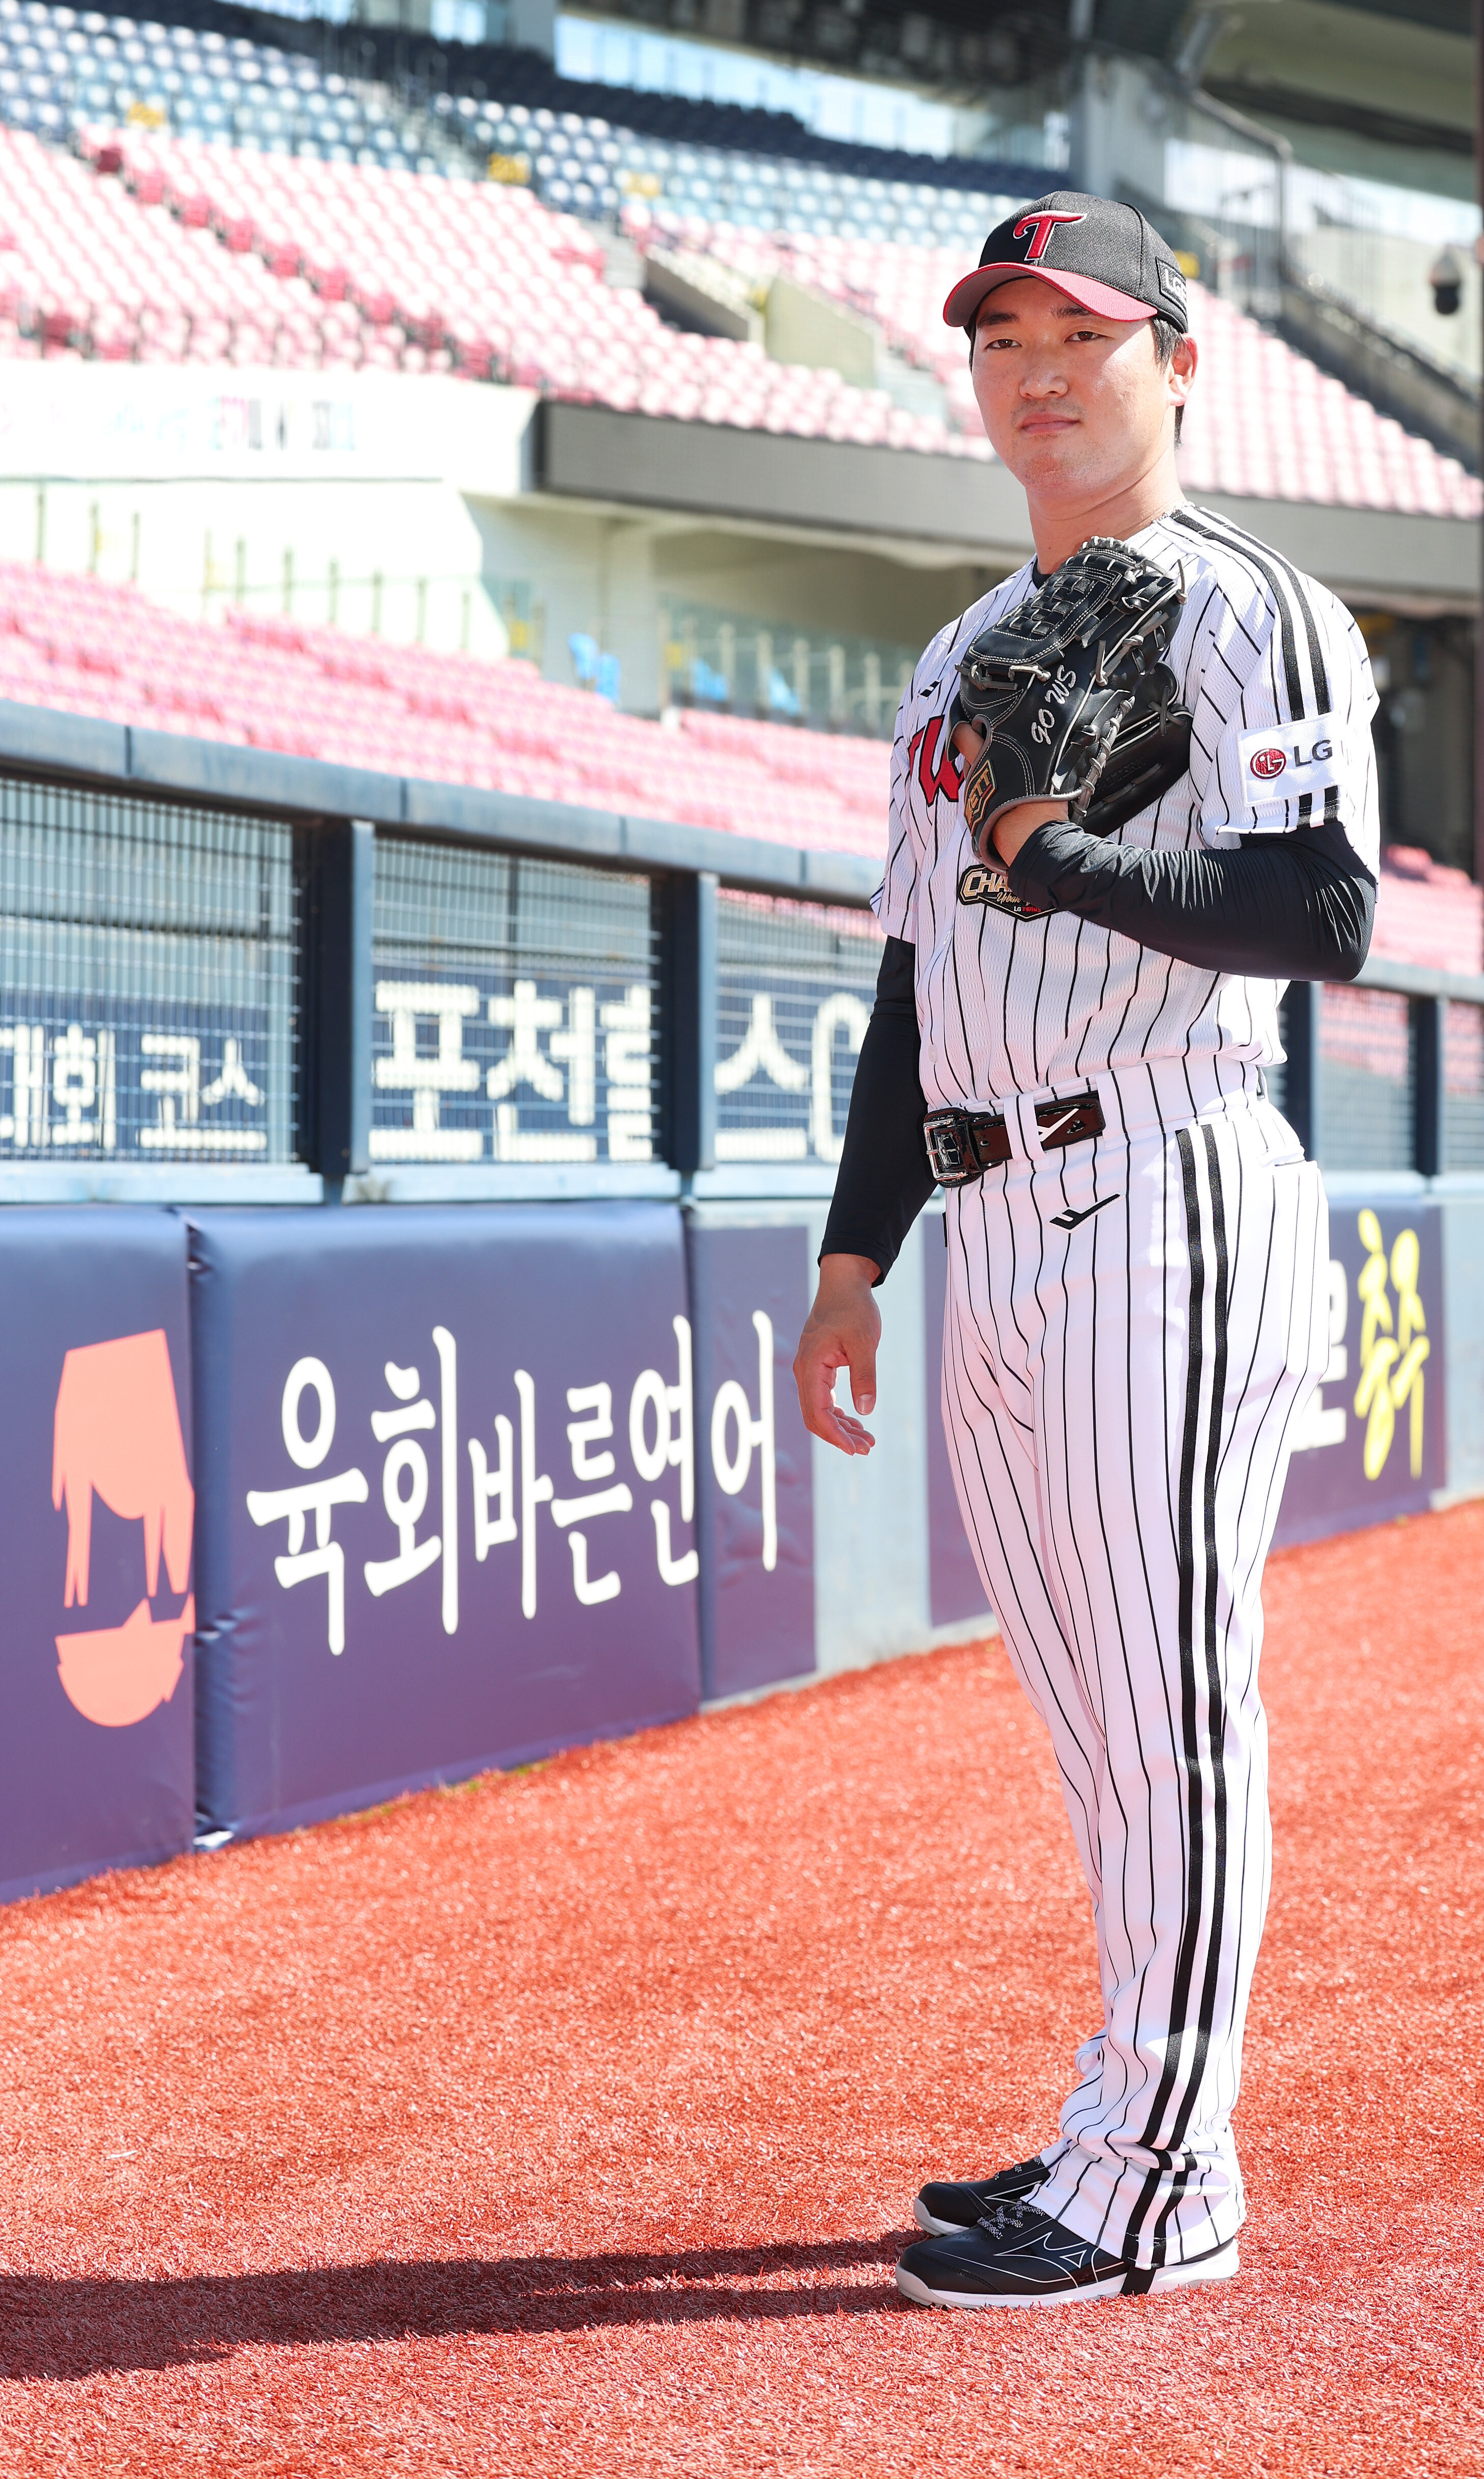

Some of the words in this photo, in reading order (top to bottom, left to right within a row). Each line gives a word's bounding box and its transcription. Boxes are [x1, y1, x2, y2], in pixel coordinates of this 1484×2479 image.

[1013, 210, 1087, 261] T
[1044, 664, 1076, 705] WS
[1293, 739, 1333, 767] LG
[964, 871, 1013, 898] CHA
[141, 1033, 268, 1151] 코스
[246, 1309, 778, 1656] 육회바른연어
